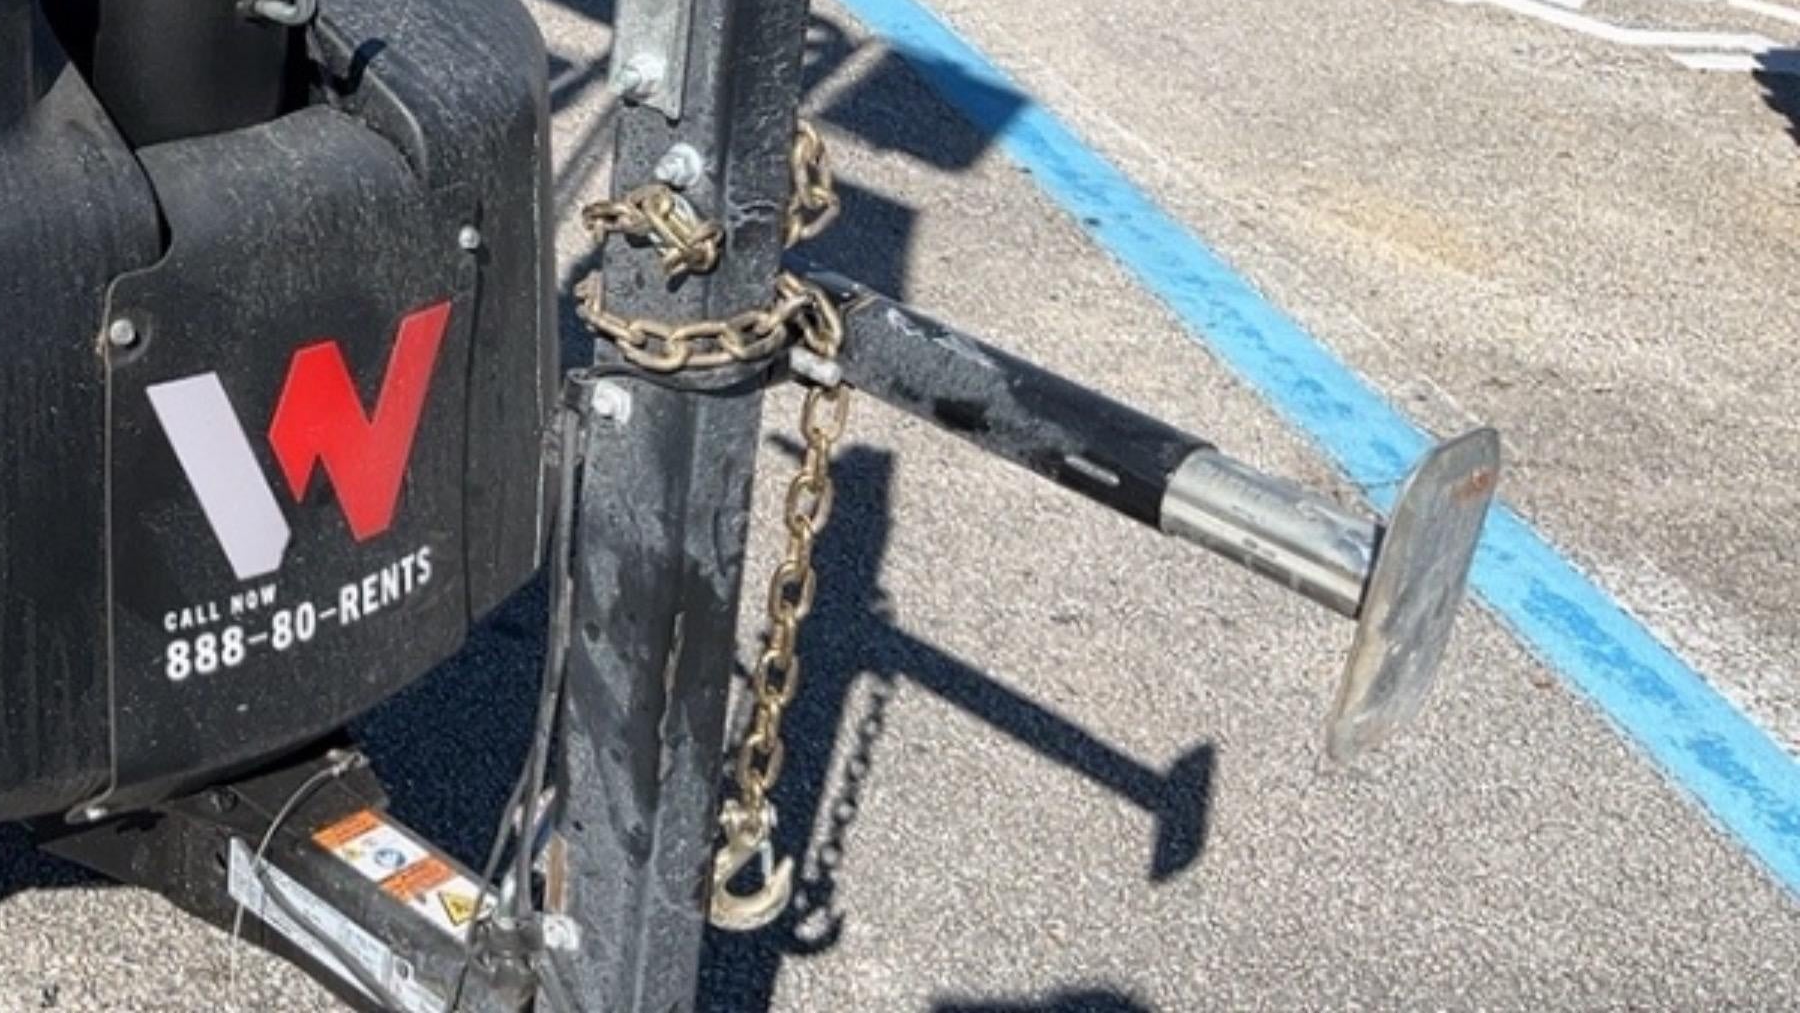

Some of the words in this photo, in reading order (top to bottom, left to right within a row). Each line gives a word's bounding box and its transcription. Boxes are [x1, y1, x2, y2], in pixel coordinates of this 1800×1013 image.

[164, 601, 220, 631] CALL
[230, 583, 278, 615] NOW
[166, 546, 433, 681] 888-80-RENTS
